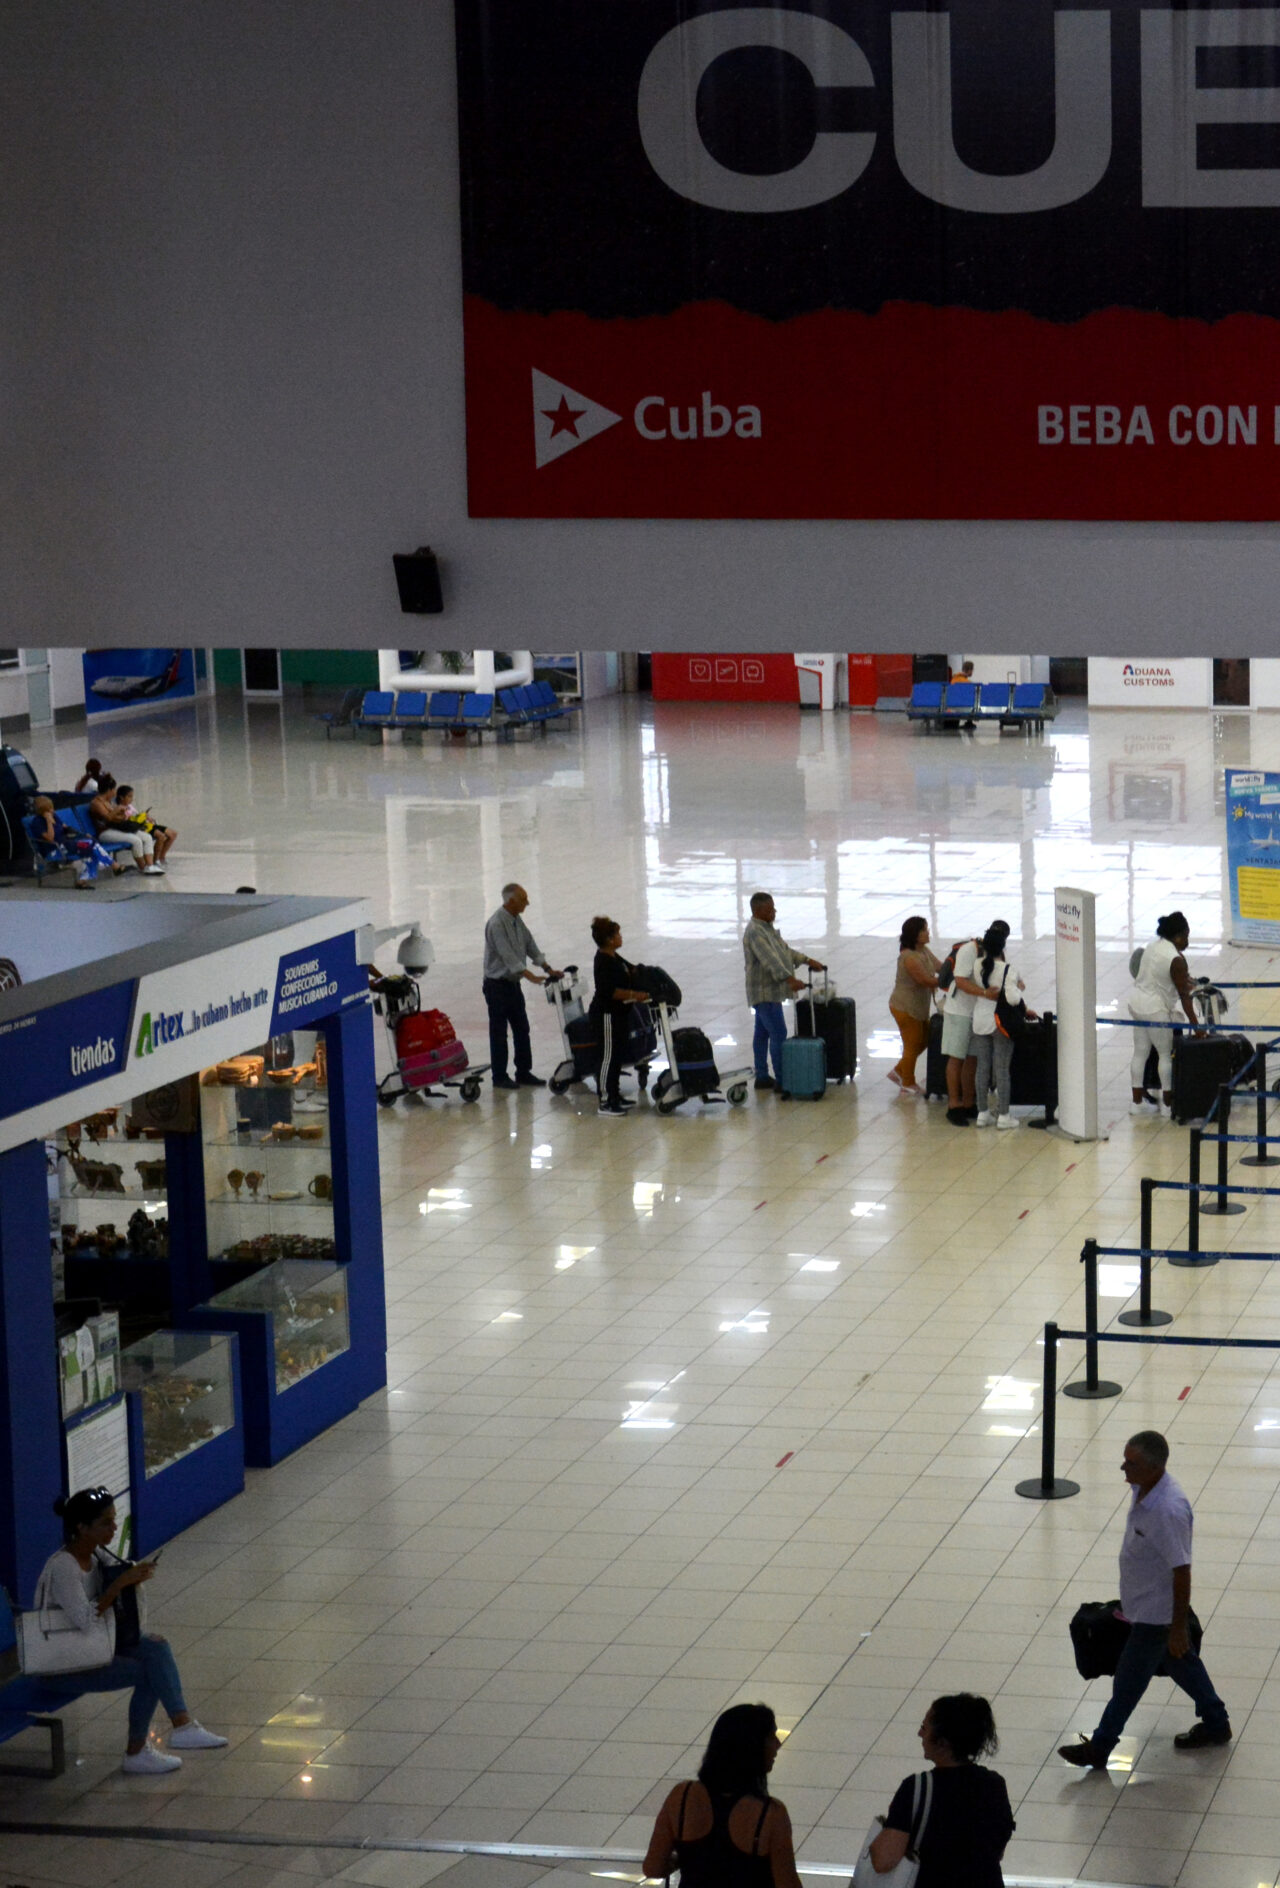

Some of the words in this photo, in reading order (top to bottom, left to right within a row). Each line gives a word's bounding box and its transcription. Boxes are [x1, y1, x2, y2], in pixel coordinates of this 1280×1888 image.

[633, 390, 762, 440] Cuba
[1038, 405, 1154, 446] BEBA
[1169, 405, 1257, 446] CON
[1123, 664, 1171, 676] ADUANA
[1123, 678, 1175, 686] CUSTOMS
[280, 970, 327, 998] CONFECCIONES
[284, 958, 319, 982] SOUVENIRS
[278, 994, 303, 1015] MUSICA
[303, 985, 328, 1005] CUBANA
[328, 981, 338, 995] CD
[135, 1011, 185, 1058] Artex
[201, 1002, 229, 1028] cubano
[229, 991, 252, 1017] hecho
[253, 987, 268, 1008] arte
[71, 1036, 116, 1077] tiendas
